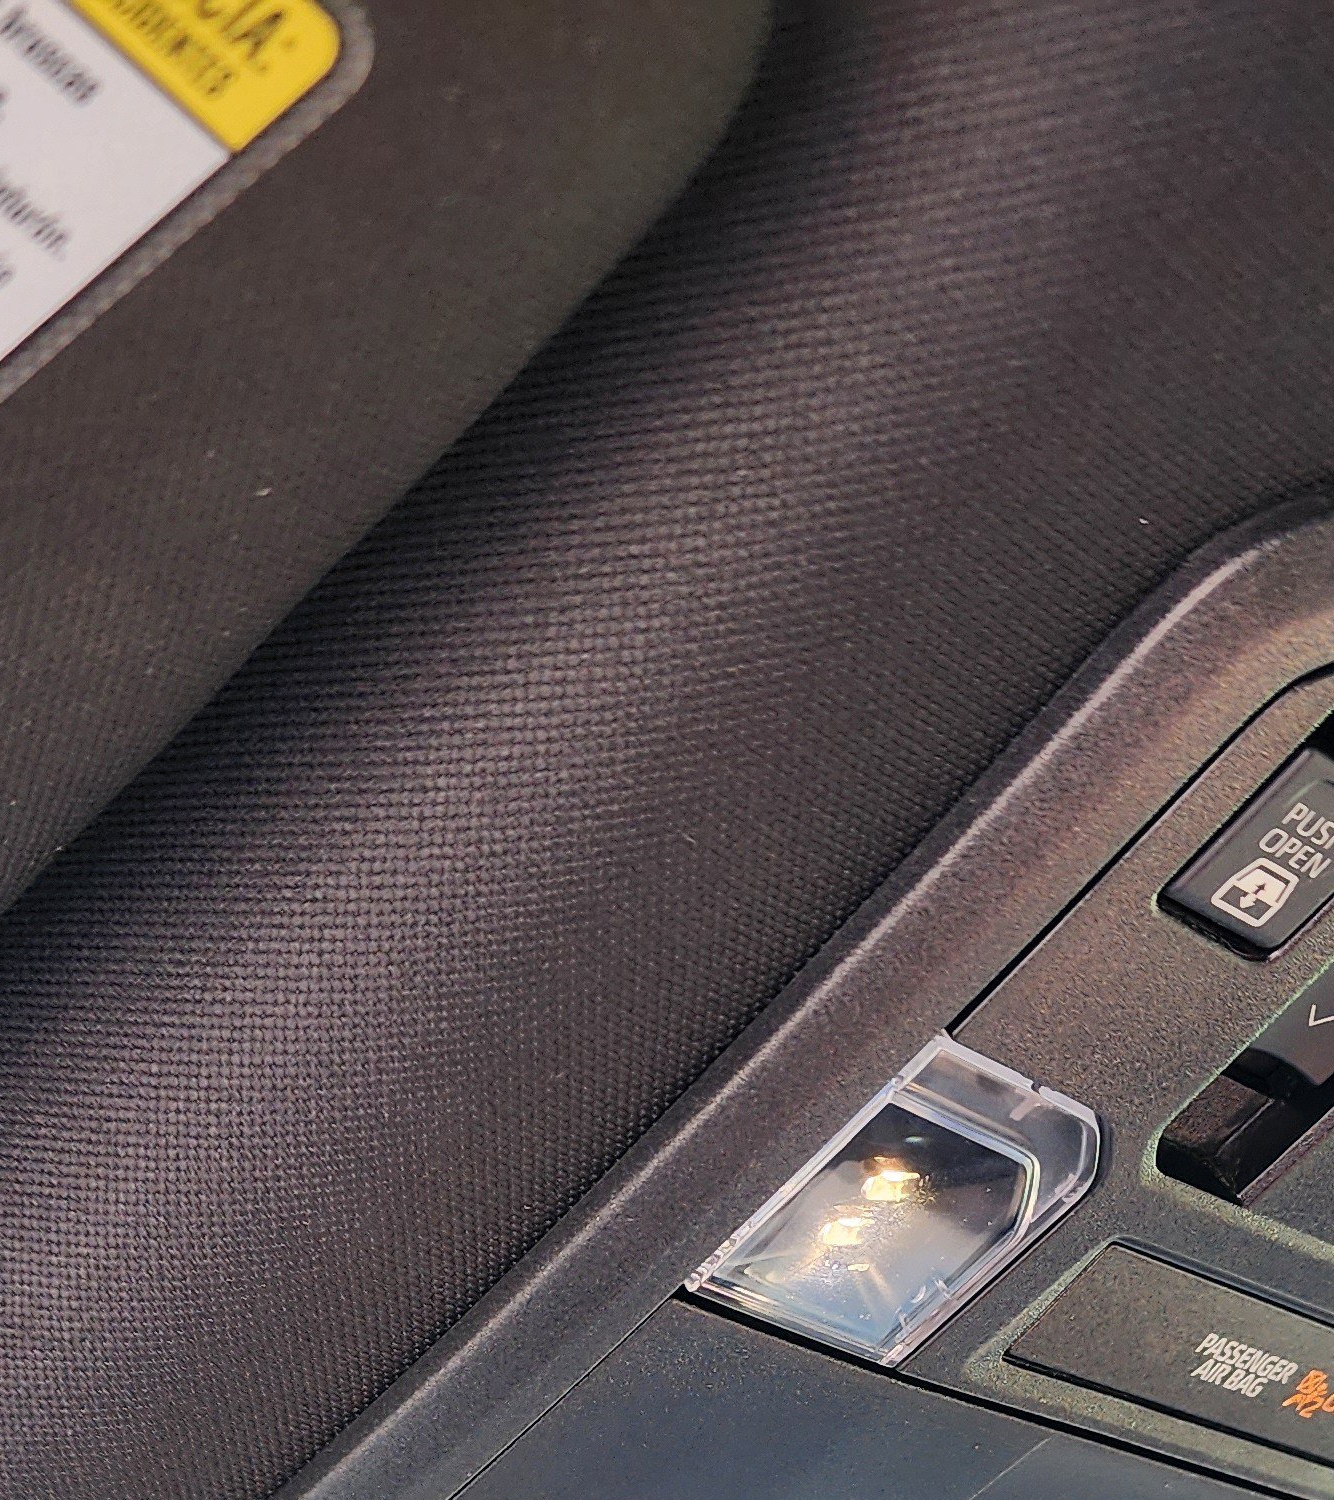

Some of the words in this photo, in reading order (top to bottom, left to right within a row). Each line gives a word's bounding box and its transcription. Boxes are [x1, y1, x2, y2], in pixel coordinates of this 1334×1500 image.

[1258, 827, 1332, 879] OPEN
[1190, 1358, 1232, 1386] AIR
[1222, 1369, 1269, 1398] BAG
[1194, 1332, 1299, 1385] PASSENGER
